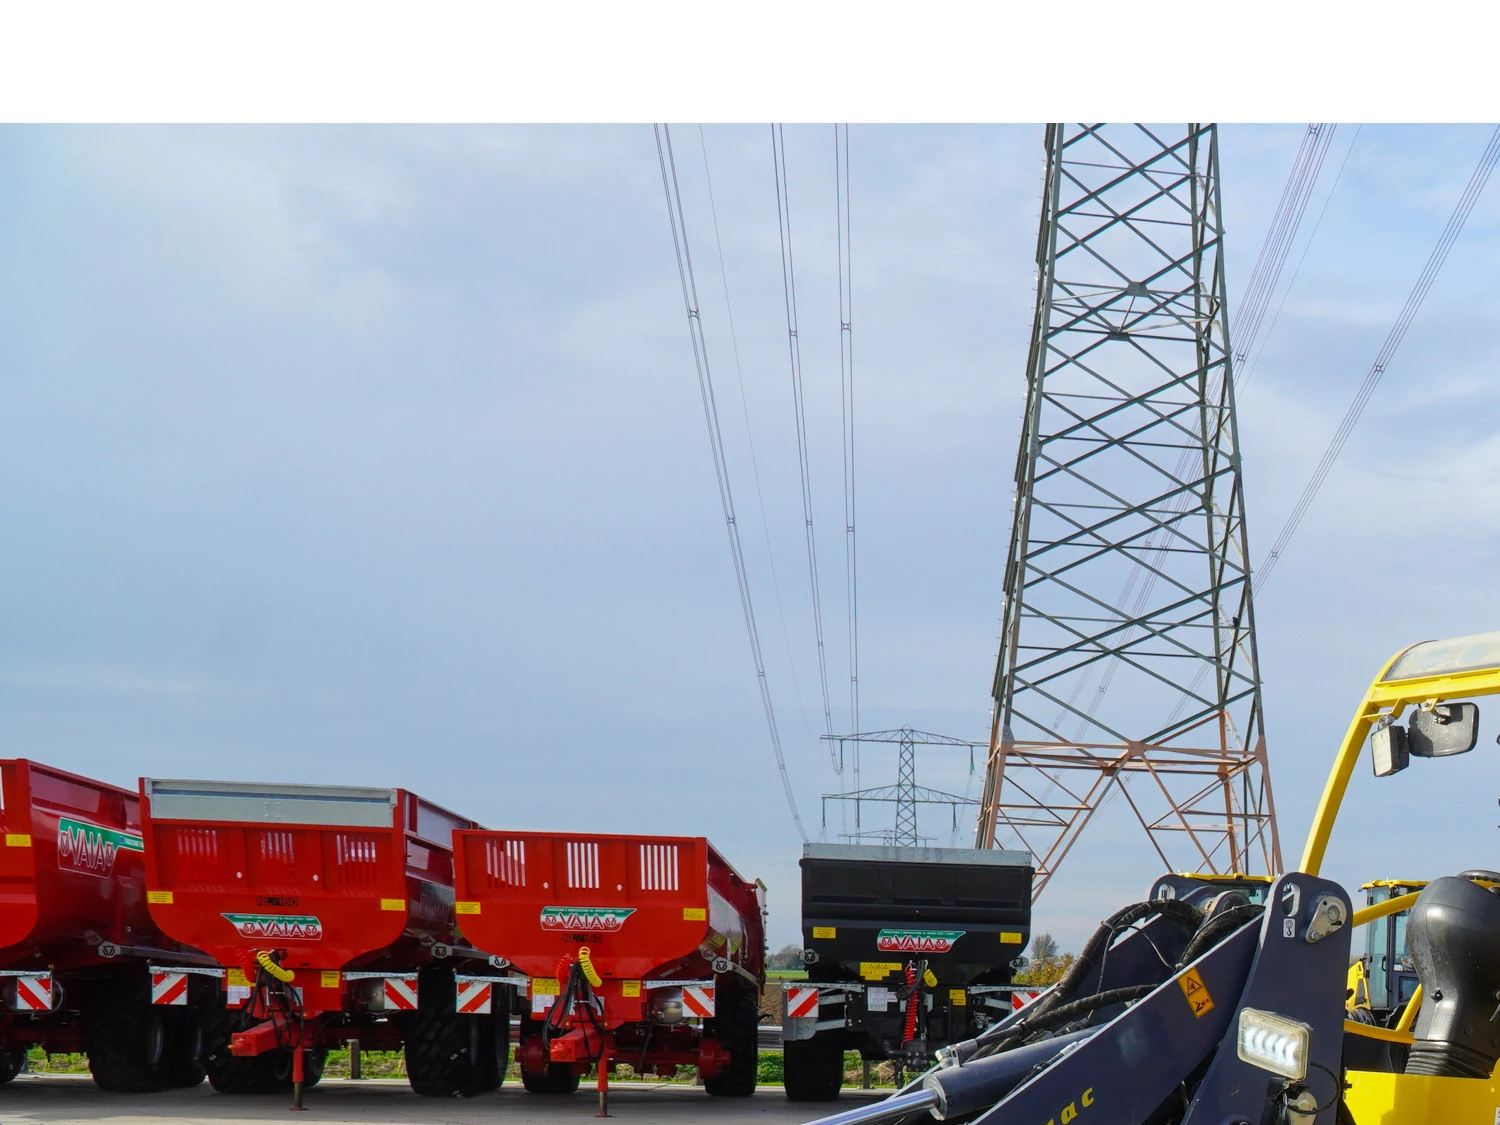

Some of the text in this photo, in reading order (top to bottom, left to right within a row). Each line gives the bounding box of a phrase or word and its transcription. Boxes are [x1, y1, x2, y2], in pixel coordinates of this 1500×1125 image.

[68, 825, 106, 871] VAIA
[257, 920, 305, 937] VAIA
[558, 912, 605, 929] VAIA
[894, 935, 936, 950] VAIA
